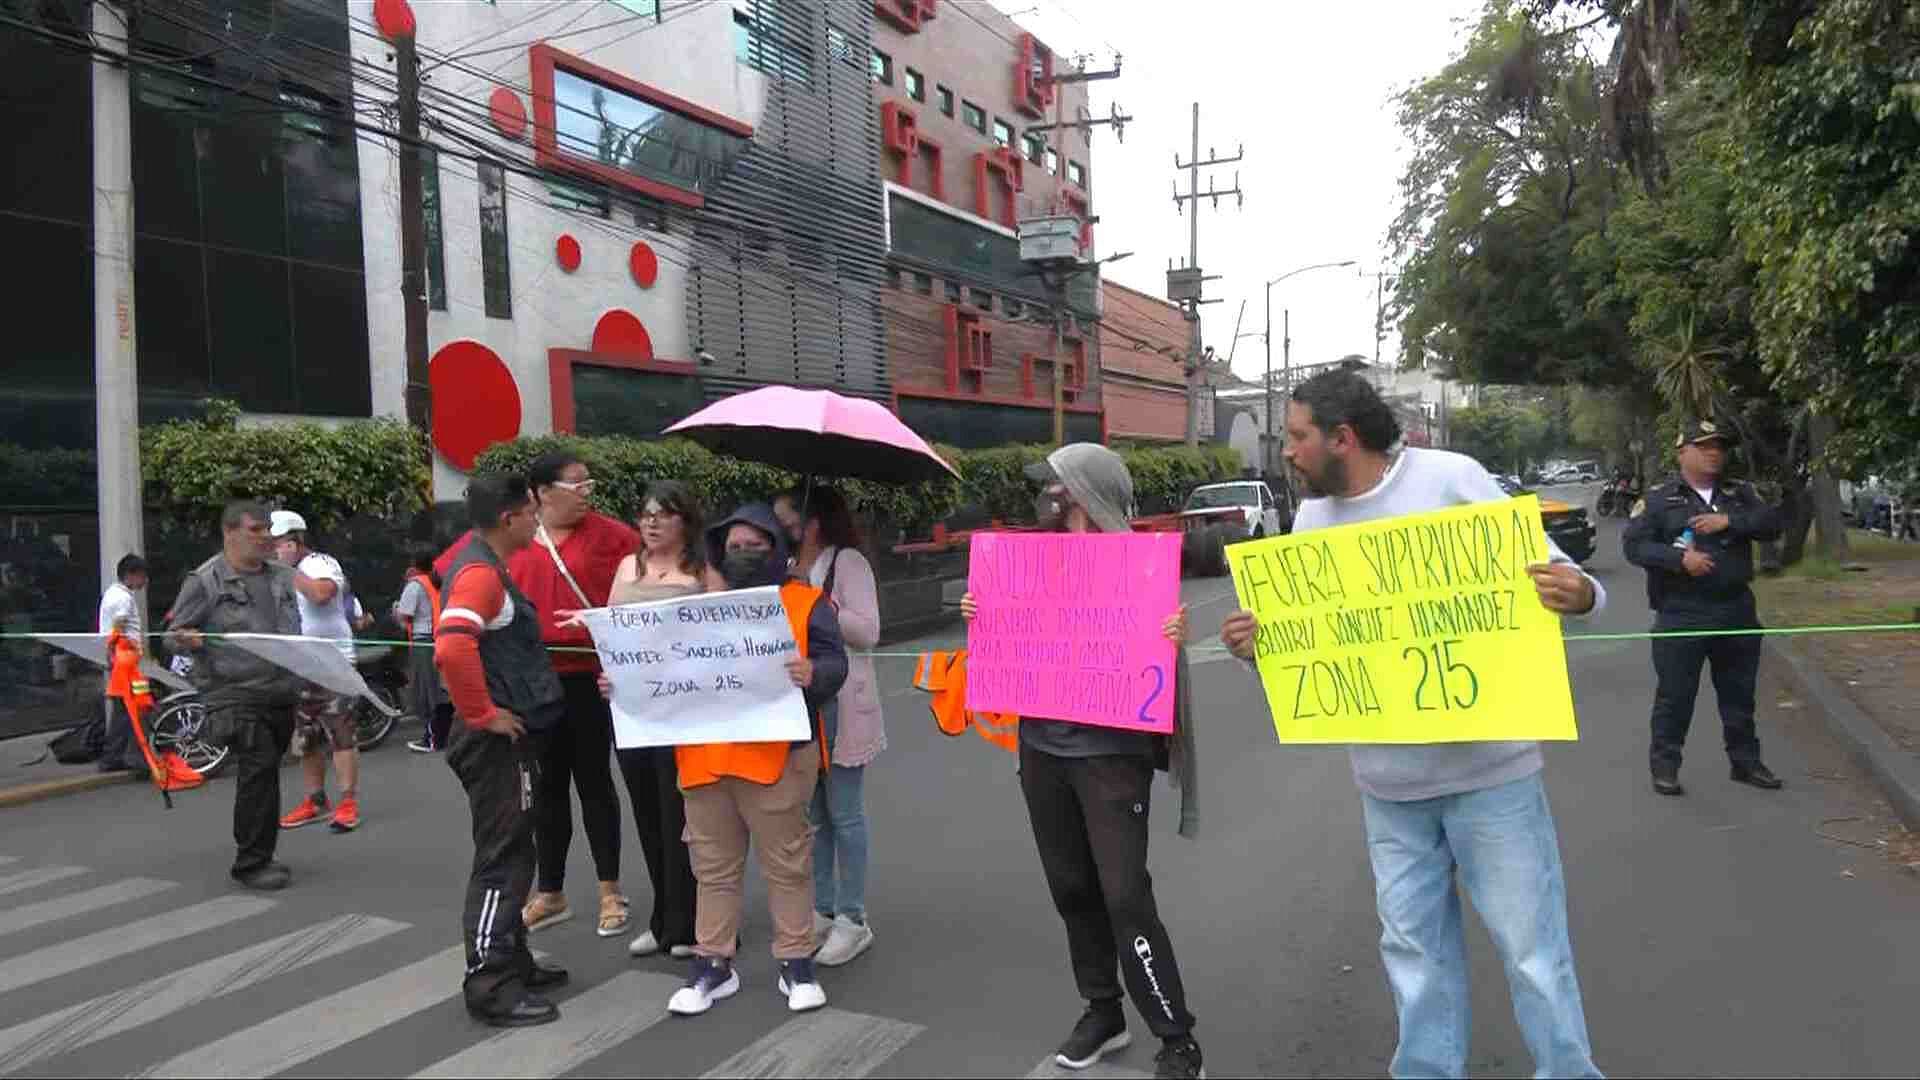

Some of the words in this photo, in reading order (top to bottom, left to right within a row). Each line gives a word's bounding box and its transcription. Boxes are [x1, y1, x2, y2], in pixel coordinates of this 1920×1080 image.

[609, 607, 664, 628] FUERA
[645, 679, 700, 698] ZONA
[713, 674, 744, 691] 215
[1138, 665, 1166, 722] 2
[1281, 656, 1384, 719] ZONA
[1402, 640, 1479, 712] 215
